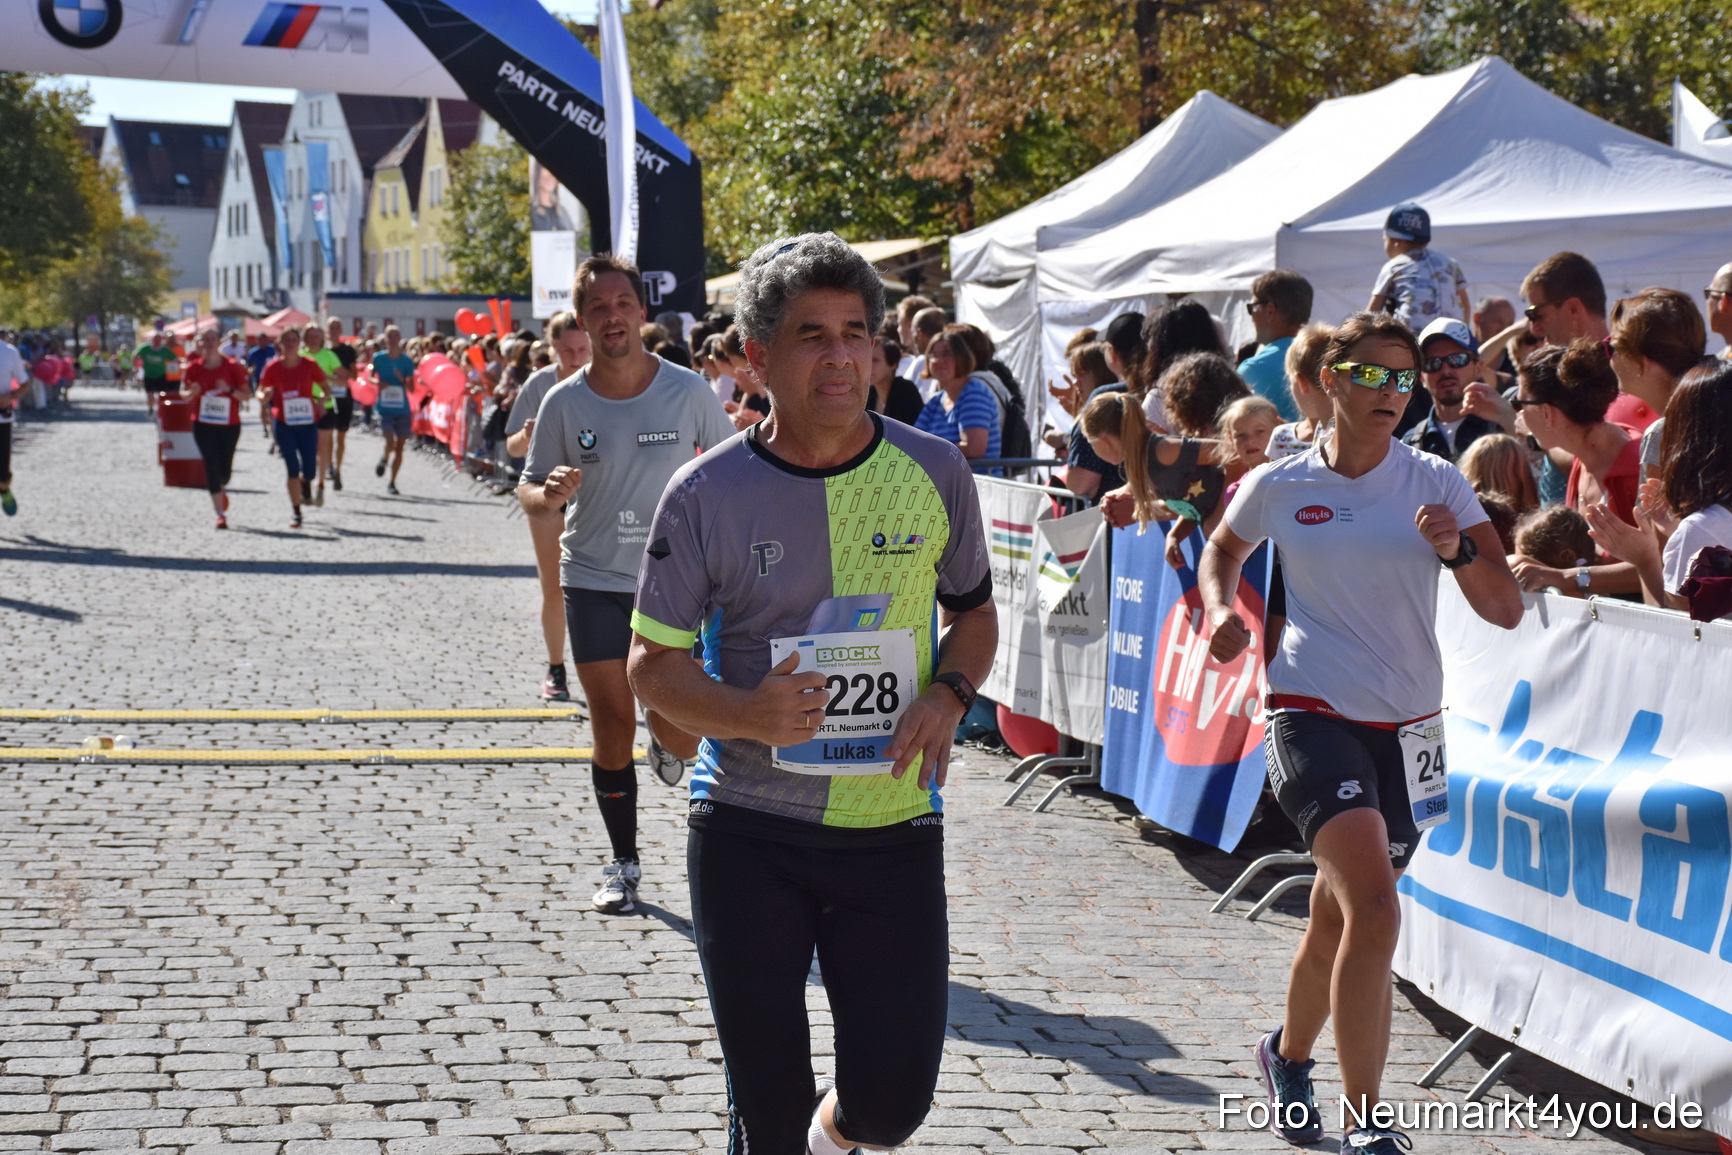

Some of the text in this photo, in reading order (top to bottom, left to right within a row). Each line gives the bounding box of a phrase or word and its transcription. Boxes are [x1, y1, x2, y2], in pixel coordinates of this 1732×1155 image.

[497, 60, 671, 175] PARTL NEURKT
[637, 431, 678, 443] BOCK
[618, 510, 640, 524] 19.
[1299, 510, 1330, 520] Hervis
[1115, 576, 1143, 603] STORE
[816, 645, 881, 663] BOCK
[816, 671, 899, 717] 228
[1109, 684, 1139, 714] OBILE
[839, 722, 880, 732] Neumarkt
[823, 742, 876, 760] Lukas
[1416, 744, 1446, 783] 24
[1424, 783, 1441, 794] PARTL
